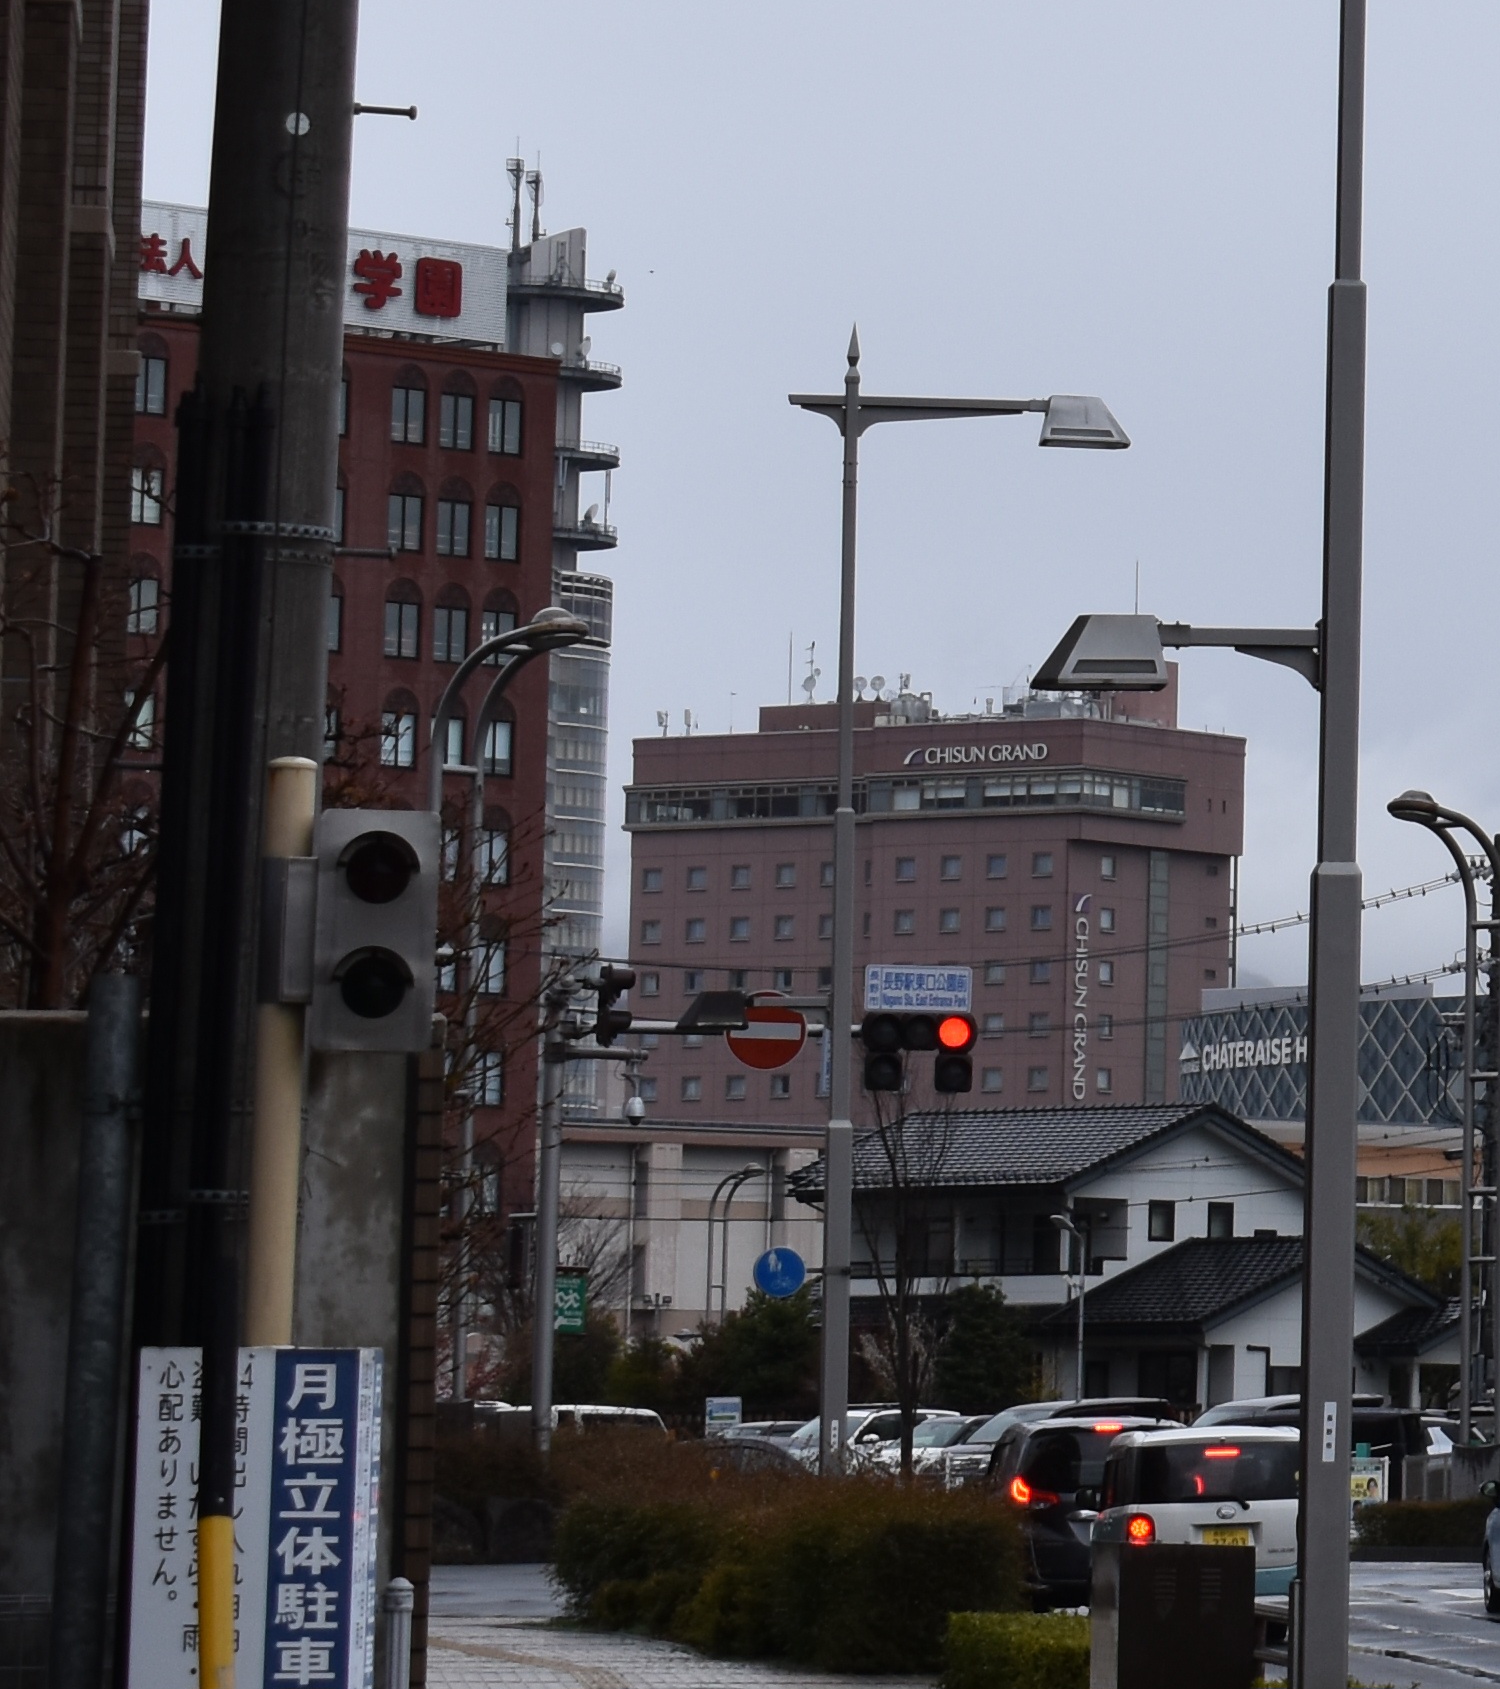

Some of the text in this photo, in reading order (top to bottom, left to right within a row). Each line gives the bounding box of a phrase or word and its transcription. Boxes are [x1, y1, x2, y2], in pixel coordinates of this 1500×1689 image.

[353, 249, 463, 318] 学園
[925, 743, 1048, 764] CHISUN GRAND
[883, 972, 967, 993] 長野駅東口公園前
[1073, 917, 1089, 1100] CHISUN GRAND
[153, 1361, 185, 1601] 心配ありません。
[274, 1363, 345, 1686] 月極立体駐車
